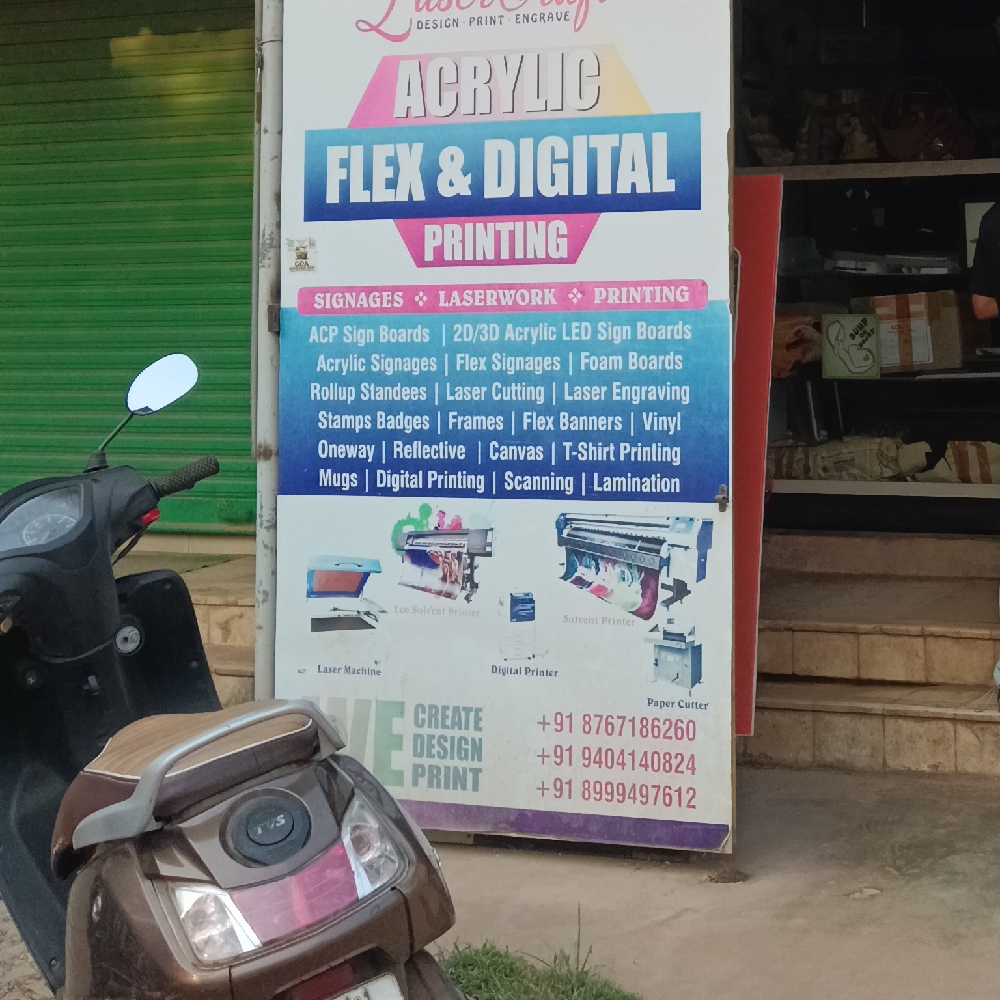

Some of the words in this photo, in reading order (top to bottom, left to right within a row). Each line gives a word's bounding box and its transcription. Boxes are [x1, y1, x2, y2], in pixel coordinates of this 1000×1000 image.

[416, 17, 459, 30] DESIGN
[469, 14, 504, 27] PRINT
[515, 10, 570, 24] ENGRAVE
[393, 48, 601, 119] ACRYLIC
[325, 142, 426, 204] FLEX
[436, 145, 473, 198] &
[483, 131, 676, 199] DIGITAL
[424, 219, 568, 262] PRINTING
[313, 291, 404, 310] SIGNAGES
[438, 288, 557, 307] LASERWORK
[593, 285, 690, 304] PRINTING
[308, 325, 339, 343] ACP
[342, 325, 375, 346] Sign
[379, 324, 430, 343] Boards
[453, 323, 500, 344] 2D/3D
[503, 322, 557, 345] Acrylic
[562, 321, 592, 341] LED
[597, 321, 631, 344] Sign
[636, 320, 692, 340] Boards
[316, 353, 366, 375] Acrylic
[370, 353, 437, 375] Signages
[456, 353, 487, 371] Flex
[491, 352, 561, 375] Signages
[580, 351, 623, 371] Foam
[628, 351, 683, 371] Boards
[310, 382, 356, 404] Rollup
[360, 382, 427, 401] Standees
[446, 382, 487, 401] Laser
[491, 381, 545, 404] Cutting
[564, 381, 608, 401] Laser
[612, 382, 690, 405] Engraving
[317, 410, 372, 433] Stamps
[376, 411, 430, 433] Badges
[448, 411, 504, 431] Frames
[522, 411, 555, 431] Flex
[559, 412, 623, 431] Banners
[642, 412, 681, 435] Vinyl
[317, 439, 375, 463] Oneway
[393, 440, 466, 459] Reflective
[489, 441, 544, 461] Canvas
[562, 442, 615, 461] T-Shirt
[619, 442, 681, 465] Printing
[319, 468, 358, 490] Mugs
[376, 469, 423, 492] Digital
[427, 470, 485, 493] Printing
[504, 470, 574, 495] Scanning
[593, 472, 681, 493] Lamination
[317, 664, 343, 674] Laser
[344, 664, 382, 676] Machine
[491, 665, 522, 676] Digital
[524, 667, 559, 677] Printer
[646, 697, 675, 710] Paper
[677, 699, 709, 711] Cutter
[413, 703, 483, 732] CREATE
[537, 711, 573, 734] +91
[581, 713, 697, 742] 8767186260
[412, 733, 483, 763] DESIGN
[536, 744, 573, 767] +91
[581, 746, 697, 776] 9404140824
[411, 763, 483, 793] PRINT
[536, 777, 572, 800] +91
[581, 779, 697, 810] 8999497612
